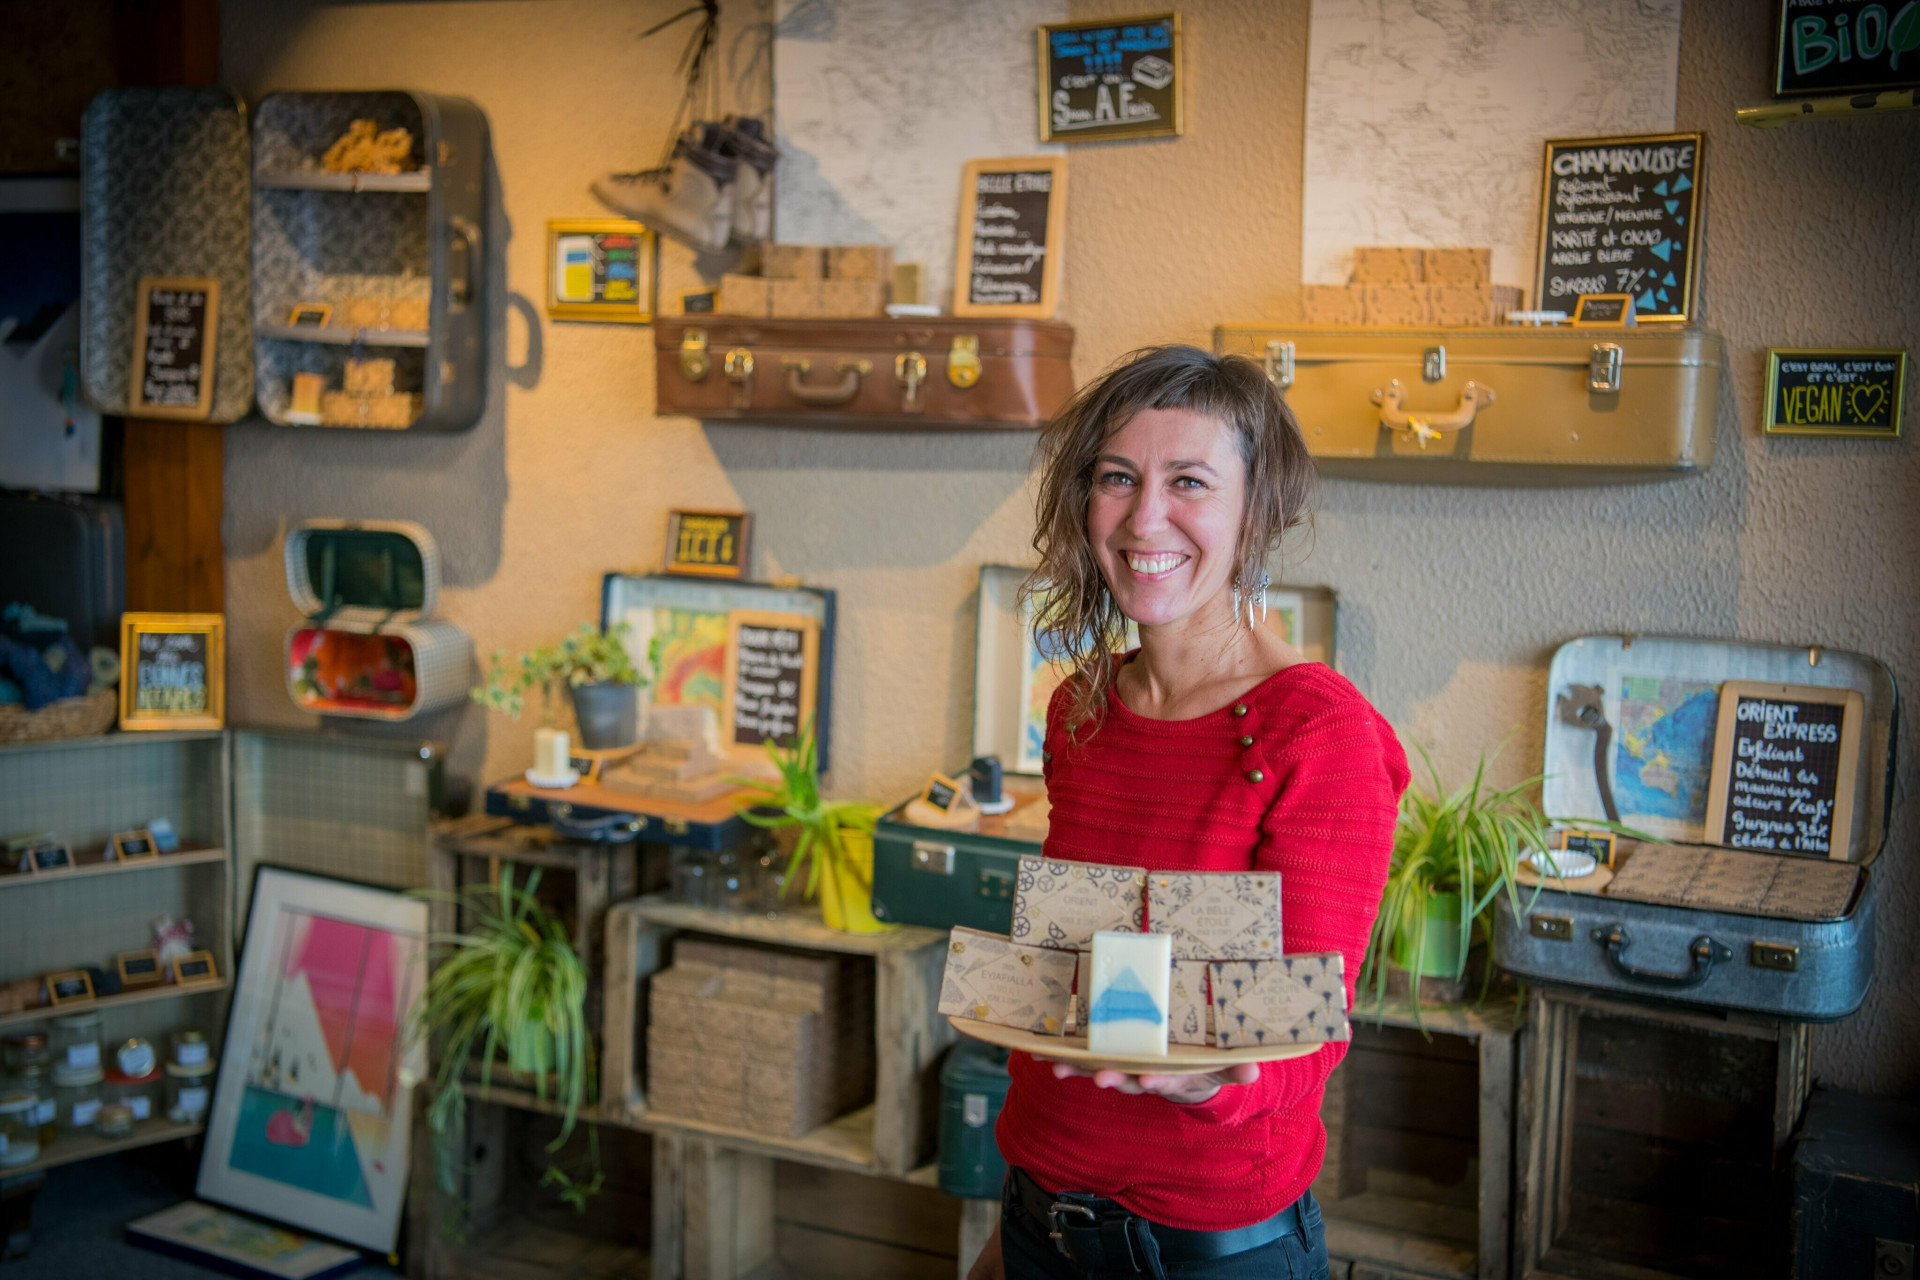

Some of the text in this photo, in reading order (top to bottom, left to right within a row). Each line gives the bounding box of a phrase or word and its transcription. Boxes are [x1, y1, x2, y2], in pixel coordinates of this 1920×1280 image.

[1792, 3, 1888, 76] BiO
[1783, 385, 1843, 424] VEGAN
[1737, 700, 1798, 723] ORIENT
[1763, 721, 1837, 743] EXPRESS
